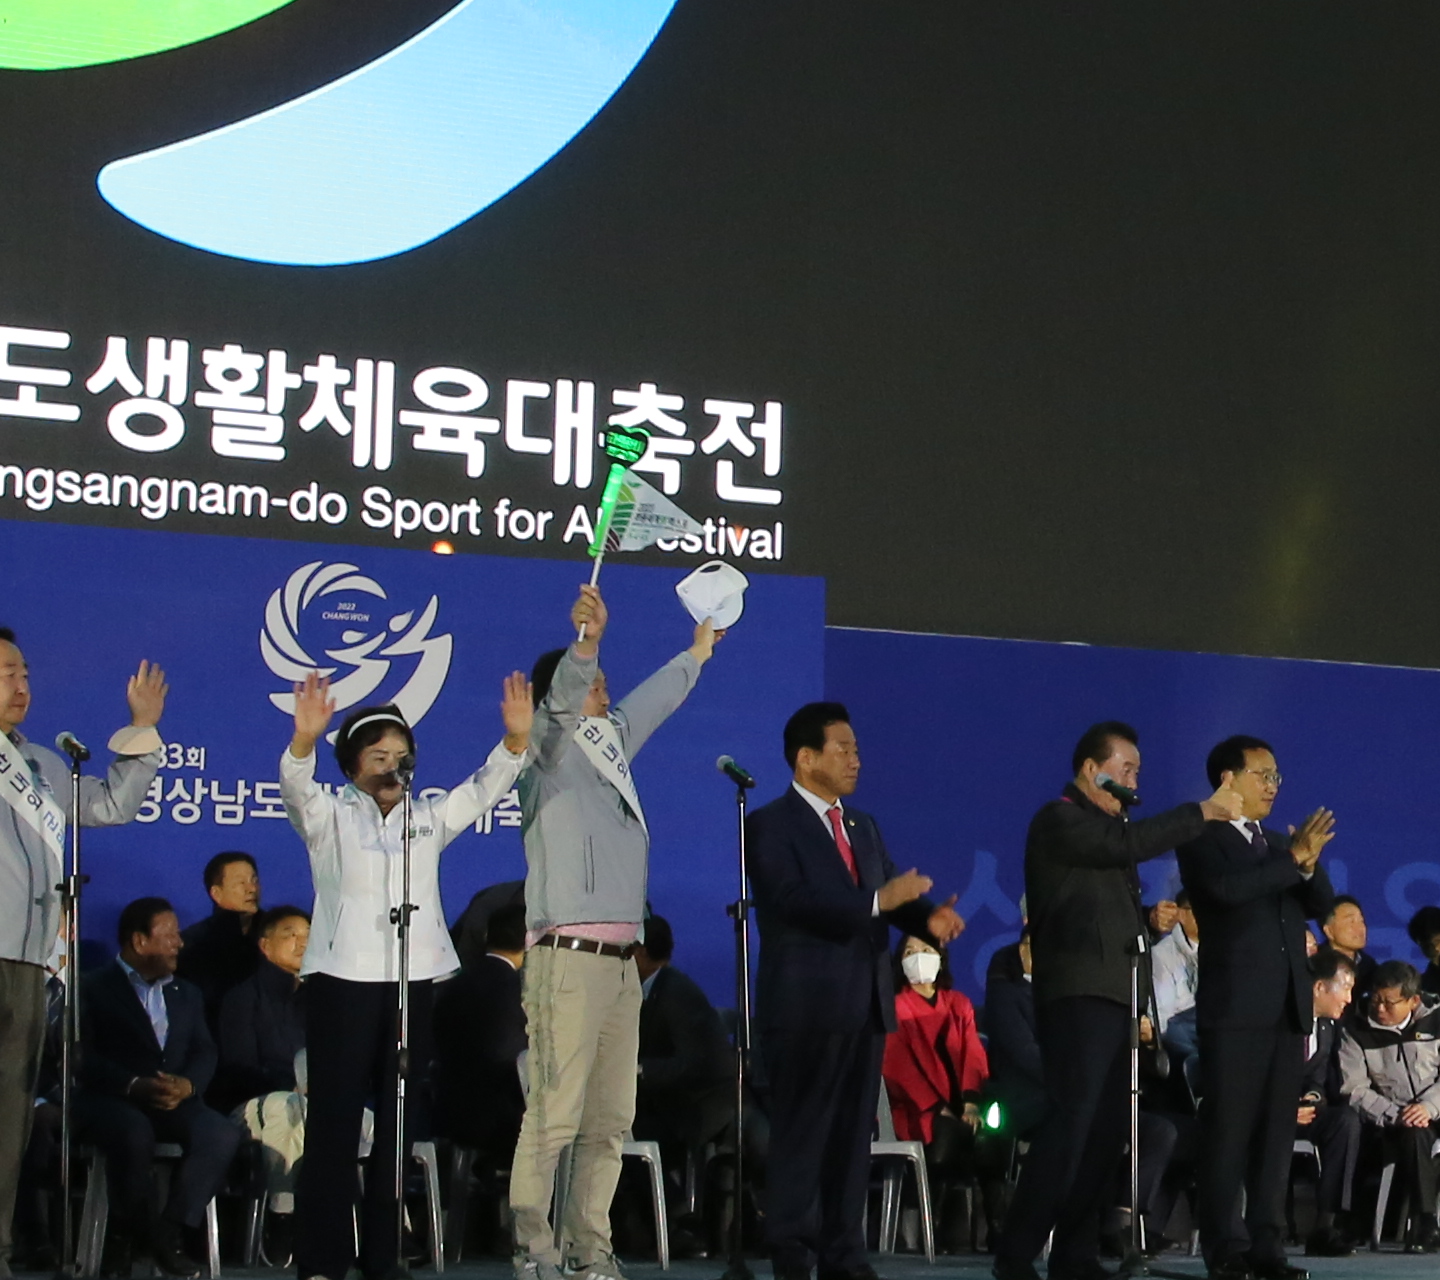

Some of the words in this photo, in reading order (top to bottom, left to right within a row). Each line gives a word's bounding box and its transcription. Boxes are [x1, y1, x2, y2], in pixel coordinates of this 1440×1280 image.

[361, 486, 483, 540] Sport
[493, 497, 555, 542] for
[656, 516, 784, 561] stival
